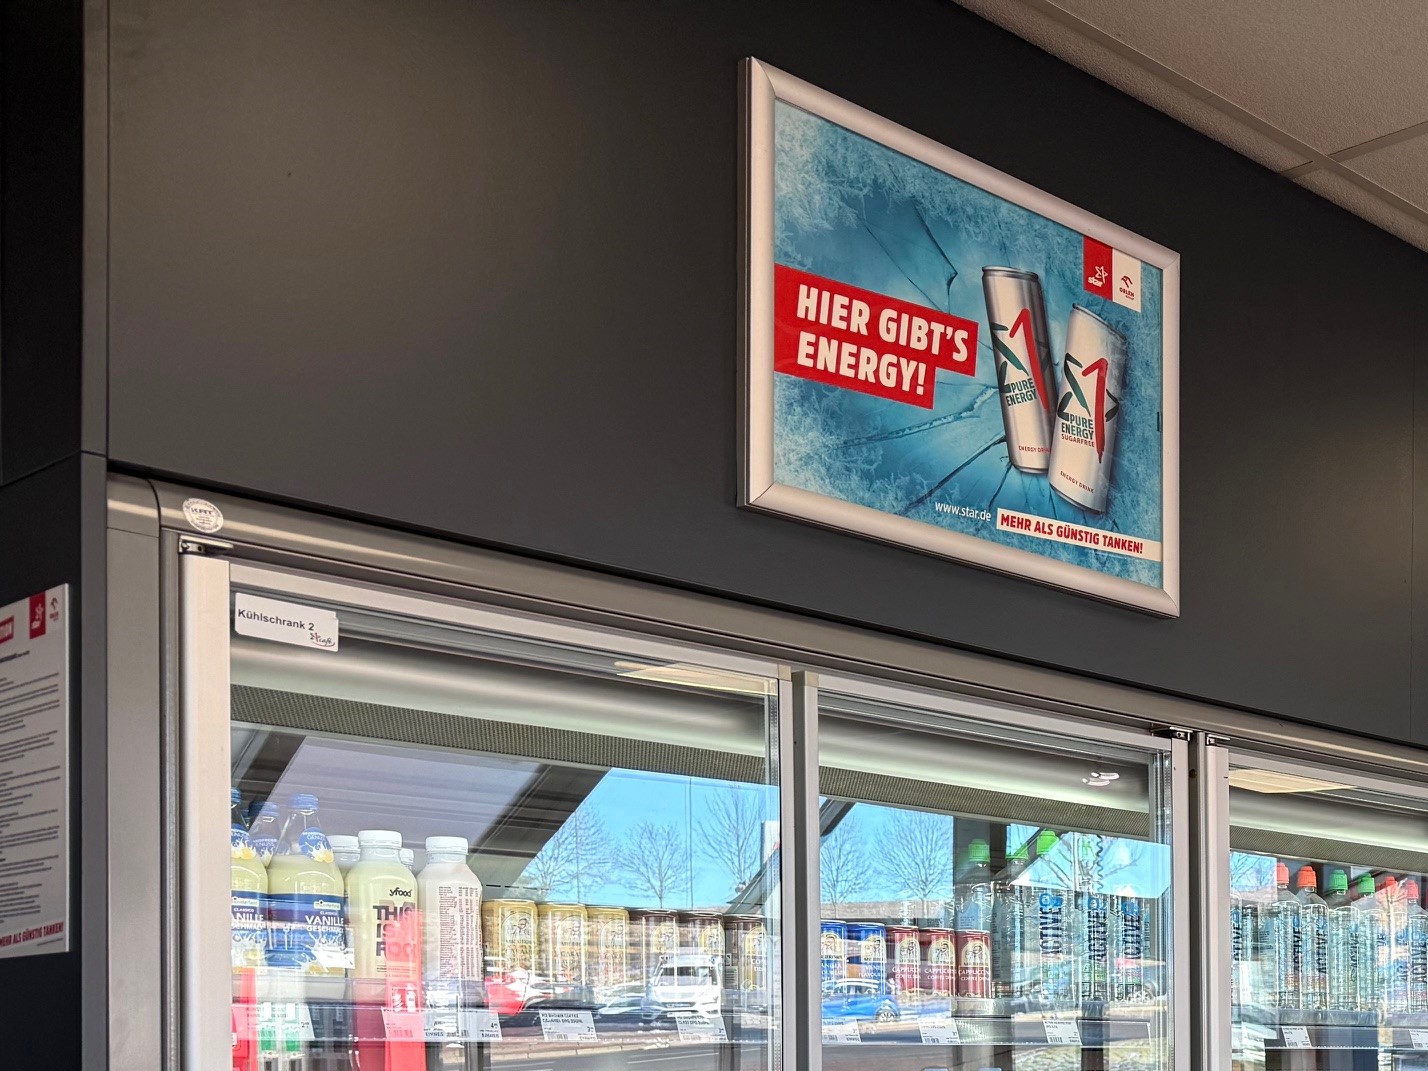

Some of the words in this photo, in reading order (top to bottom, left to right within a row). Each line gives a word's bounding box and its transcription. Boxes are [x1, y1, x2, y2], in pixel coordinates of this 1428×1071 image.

[1088, 277, 1103, 287] star
[1120, 288, 1134, 297] ORLEN
[797, 284, 870, 336] HIER
[879, 308, 968, 362] GIBT'S
[798, 331, 926, 395] ENERGY!
[1010, 378, 1034, 392] PURE
[1006, 389, 1036, 406] ENERGY
[1070, 415, 1093, 429] PURE
[1062, 422, 1094, 440] ENERGY
[1062, 434, 1094, 447] SUGARFREE
[1061, 471, 1078, 486] ENERGY
[1079, 482, 1094, 493] DRINK
[935, 502, 991, 521] www.star.de
[1001, 514, 1031, 531] MEHR
[1034, 521, 1053, 535] ALS
[1056, 525, 1099, 545] GÜNSTIG
[1102, 535, 1143, 553] TANKEN!
[238, 608, 305, 629] Kühlschrank
[309, 622, 314, 630] 2
[390, 887, 412, 897] yfood
[305, 915, 344, 925] VANILLE
[12, 929, 21, 944] ALS
[22, 925, 43, 943] GÜNSTIG
